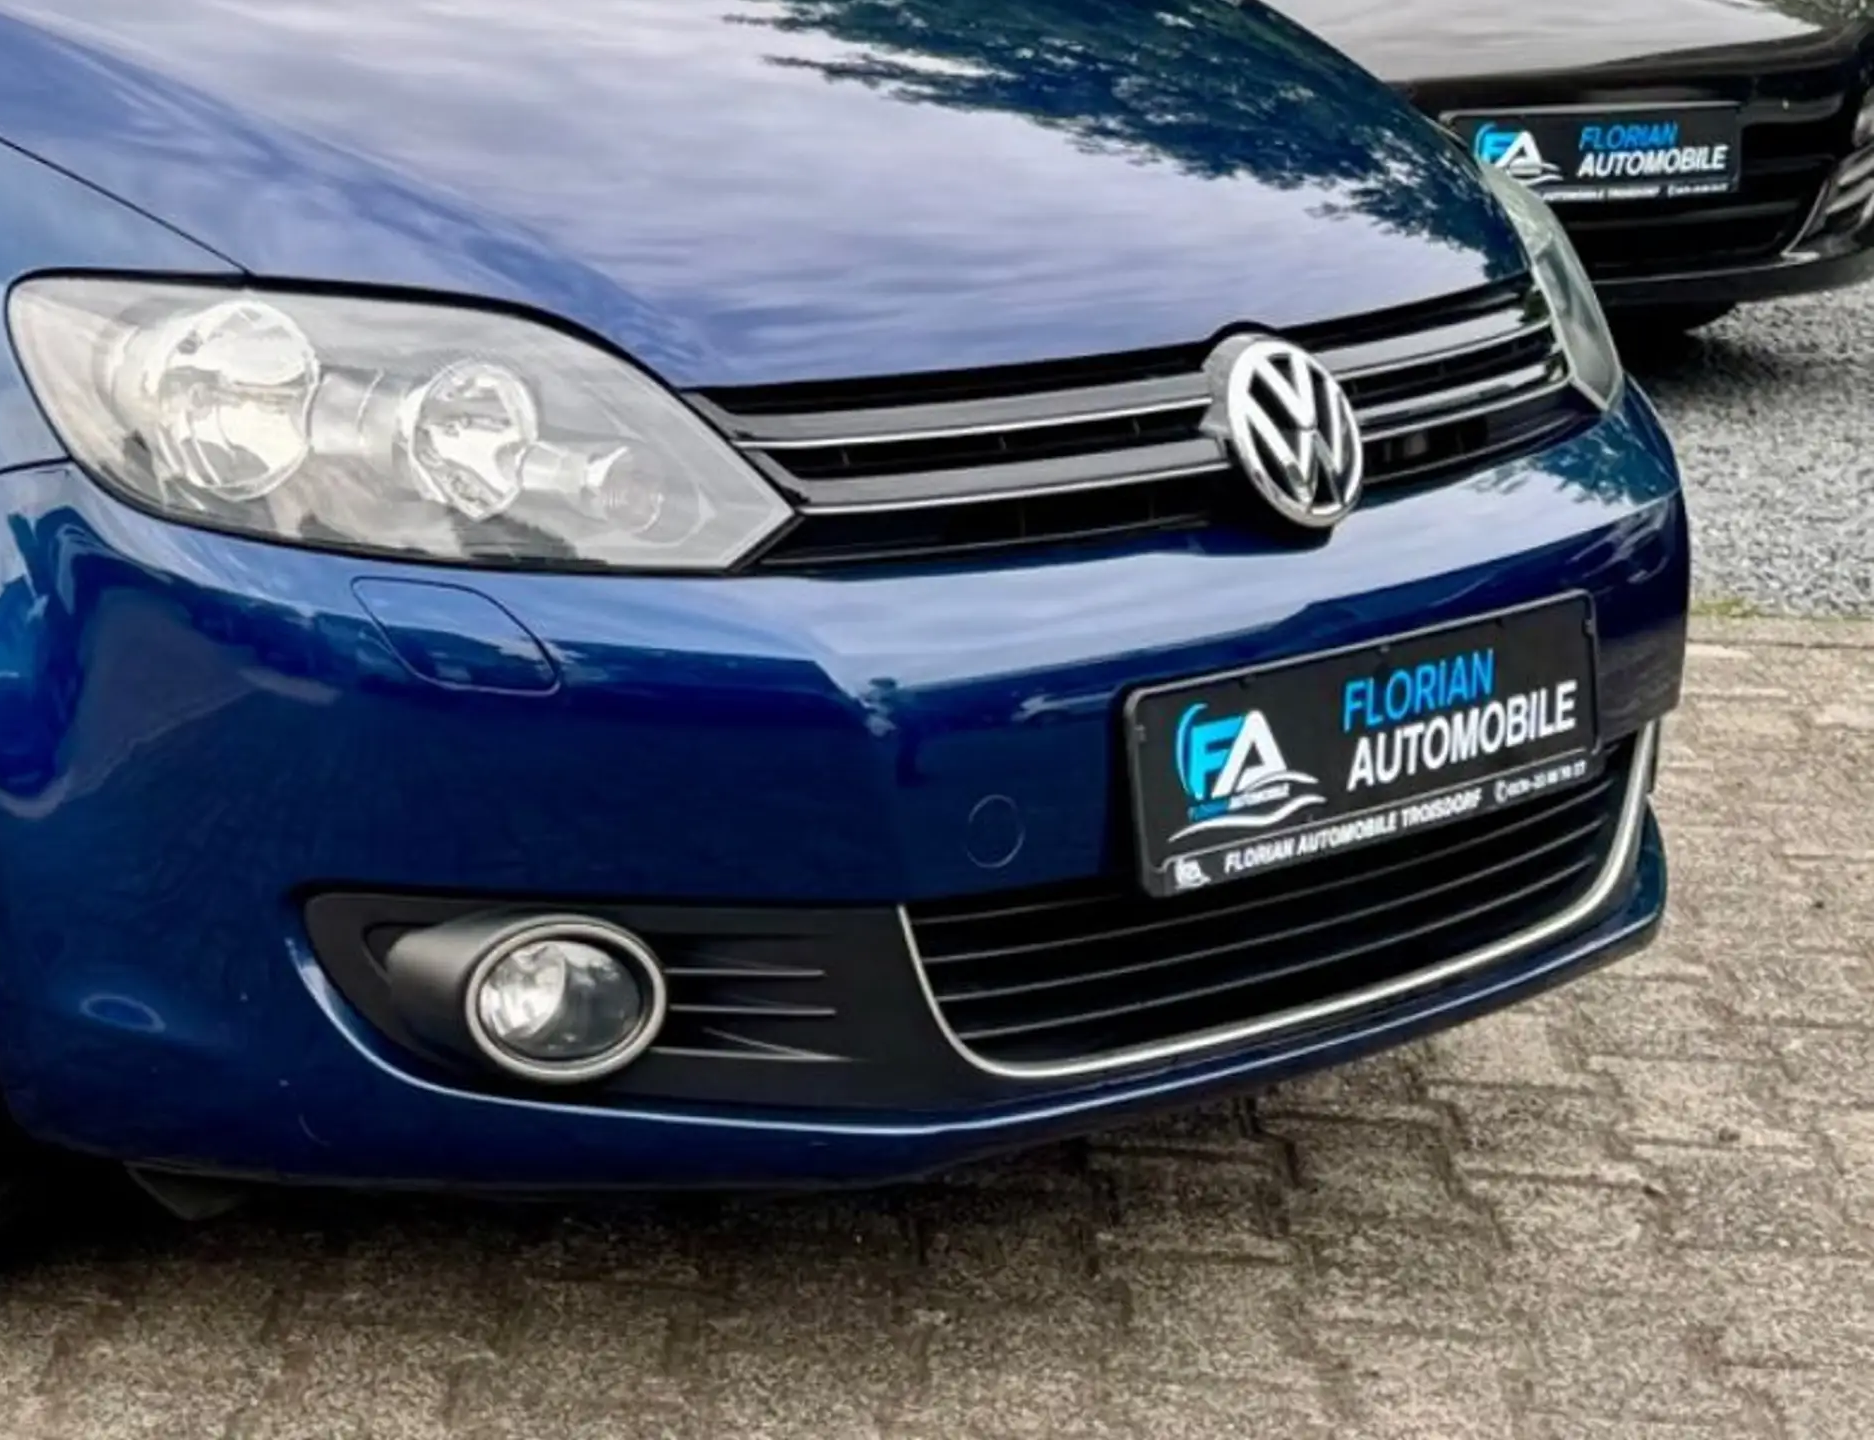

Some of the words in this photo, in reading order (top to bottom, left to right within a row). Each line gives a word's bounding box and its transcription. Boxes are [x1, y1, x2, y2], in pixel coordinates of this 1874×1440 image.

[1579, 122, 1679, 151] FLORIAN
[1576, 144, 1729, 178] AUTOMOBILE
[1343, 648, 1494, 733] FLORIAN
[1346, 679, 1578, 792] AUTOMOBILE
[1296, 809, 1398, 856] AUTOMOBILE
